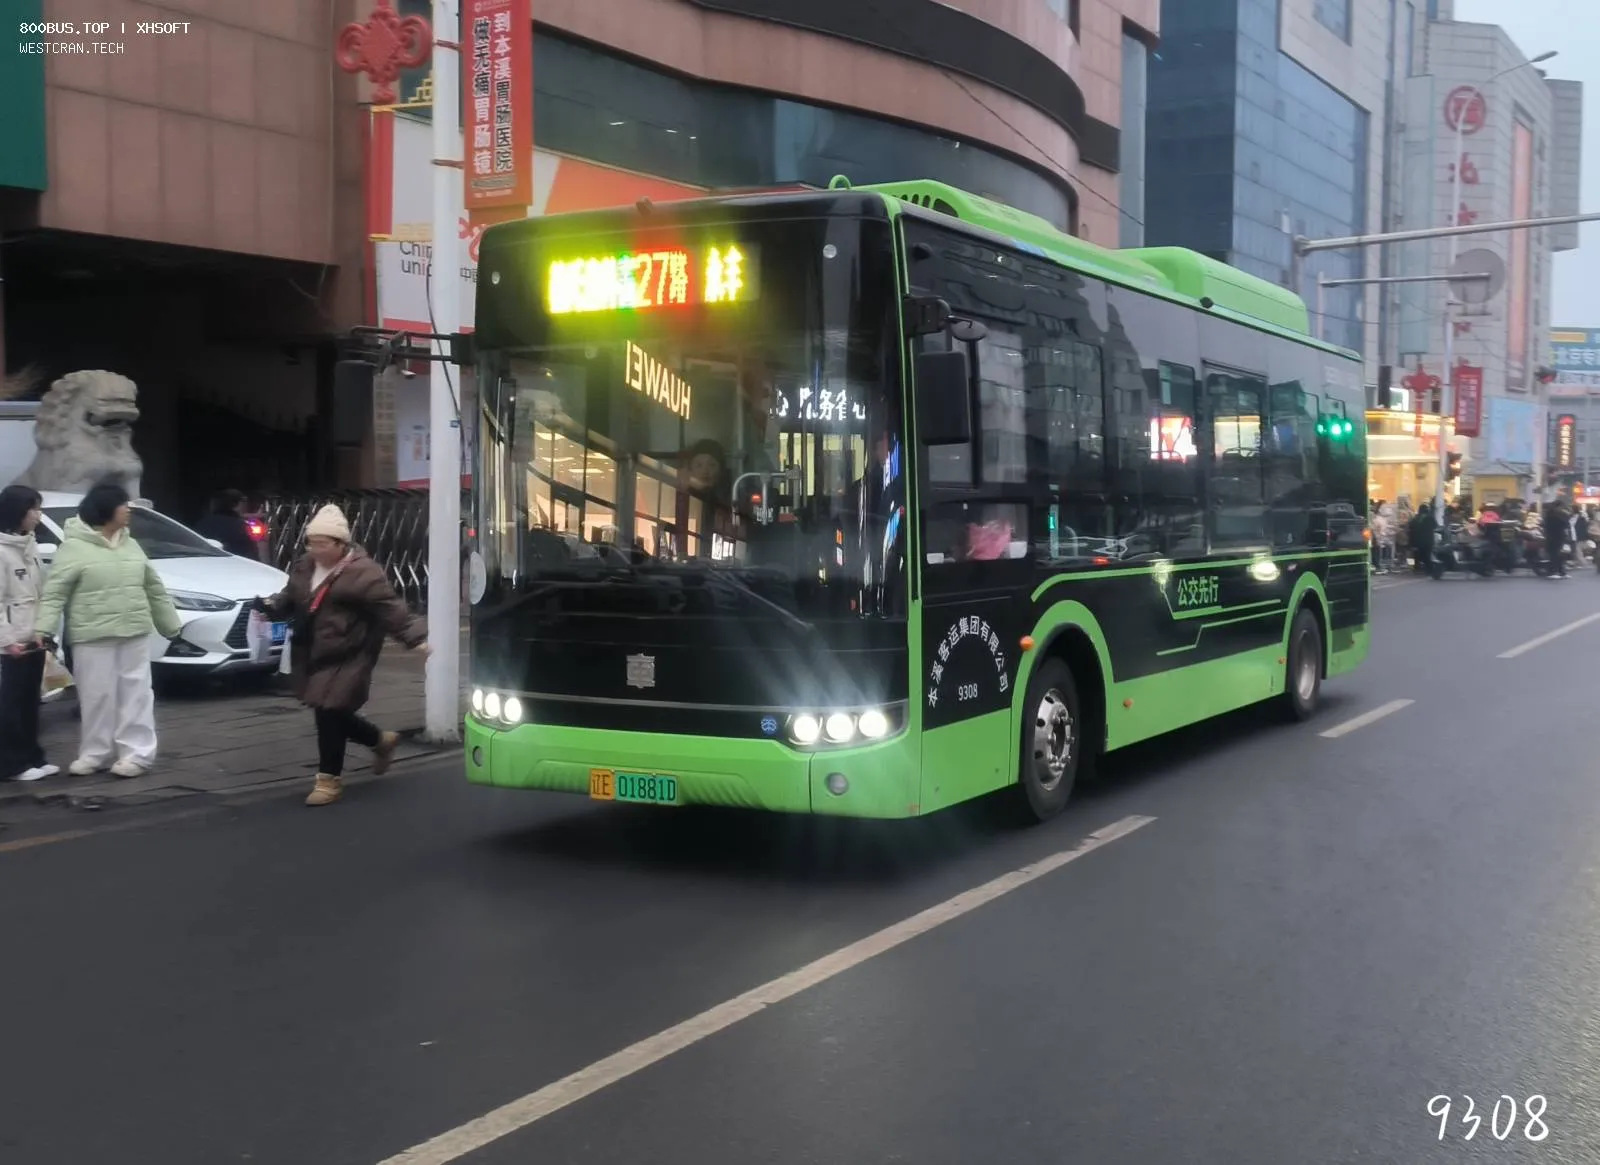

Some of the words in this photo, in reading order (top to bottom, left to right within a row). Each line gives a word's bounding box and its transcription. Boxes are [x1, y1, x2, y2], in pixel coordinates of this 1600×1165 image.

[494, 11, 513, 173] 到本溪胃肠医院
[1177, 575, 1219, 606] 公交先行
[928, 615, 1009, 708] 本溪客运集团有限公司
[958, 683, 978, 701] 9308
